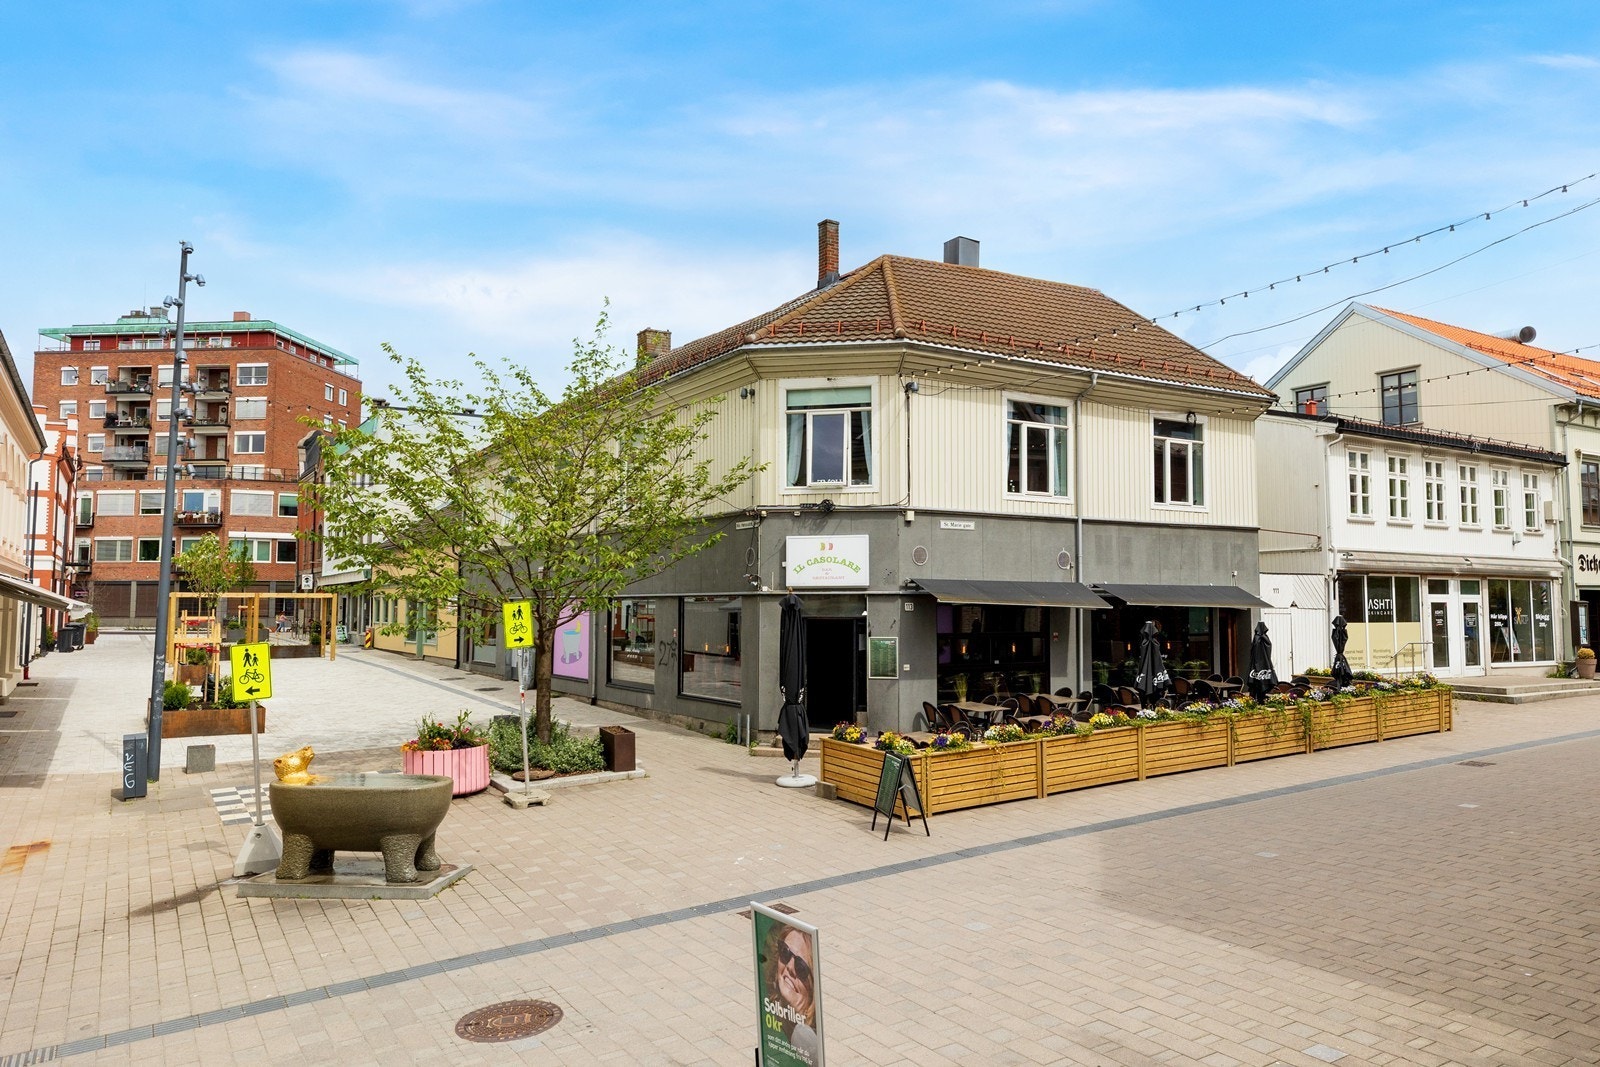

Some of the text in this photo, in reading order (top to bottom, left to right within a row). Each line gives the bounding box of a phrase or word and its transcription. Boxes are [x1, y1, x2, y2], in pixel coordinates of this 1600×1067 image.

[793, 556, 861, 574] IL CASOLARE
[1578, 554, 1600, 575] Dick
[1368, 598, 1393, 610] ASHTI
[764, 997, 807, 1027] Solbriller
[772, 1015, 783, 1033] kr
